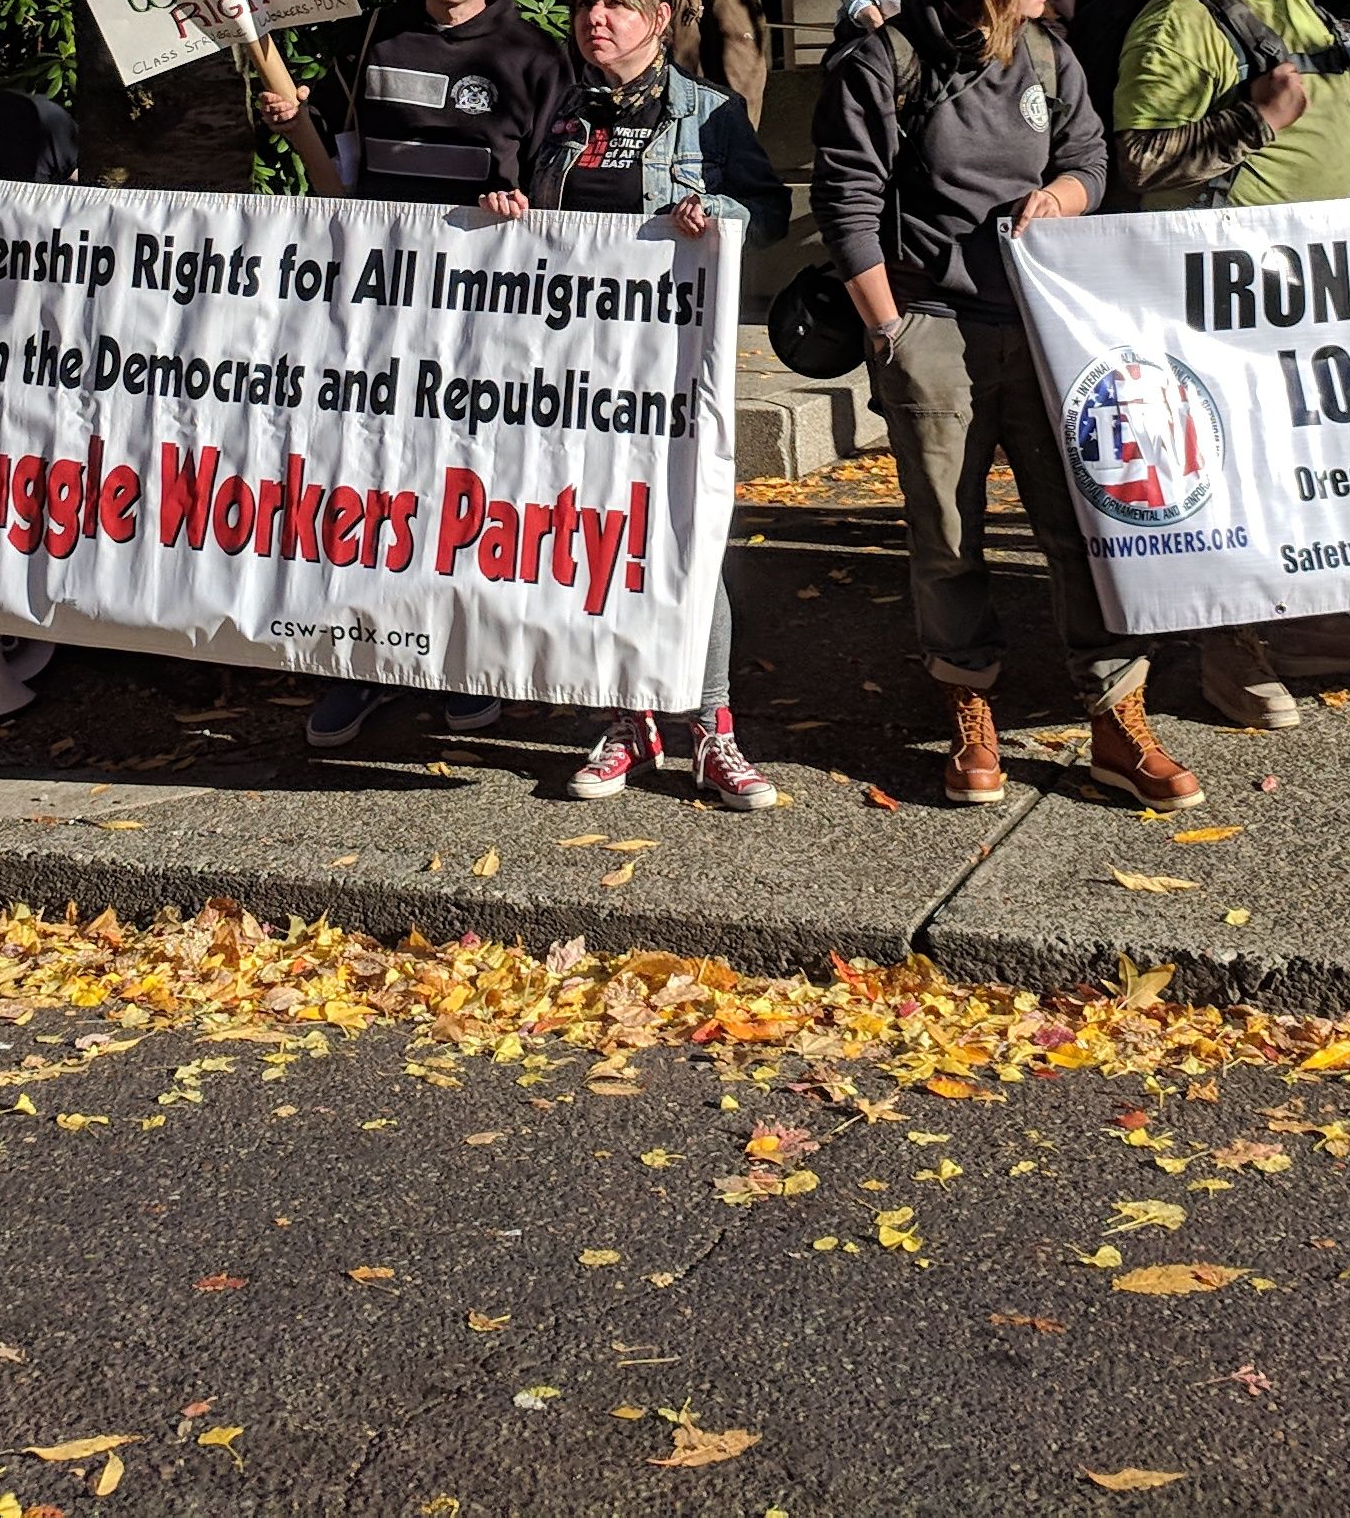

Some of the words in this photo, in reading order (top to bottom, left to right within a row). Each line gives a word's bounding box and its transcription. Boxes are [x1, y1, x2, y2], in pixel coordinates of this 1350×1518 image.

[132, 49, 179, 75] CLASS
[184, 27, 247, 54] STRUGGLE
[605, 149, 617, 158] of
[609, 138, 645, 148] GUILD
[601, 159, 633, 168] EAST
[131, 232, 264, 307] Rights
[277, 242, 341, 303] for
[350, 247, 418, 308] All
[431, 250, 707, 332] Immigrants!
[21, 329, 85, 391] the
[92, 334, 306, 409] Democrats
[317, 356, 401, 416] and
[414, 358, 699, 440] Republicans!
[159, 440, 420, 574] Workers
[434, 465, 651, 617] Party!
[1162, 503, 1181, 520] AND
[1085, 525, 1249, 560] ONWORKERS.ORG
[269, 616, 433, 656] csw-pdx.org
